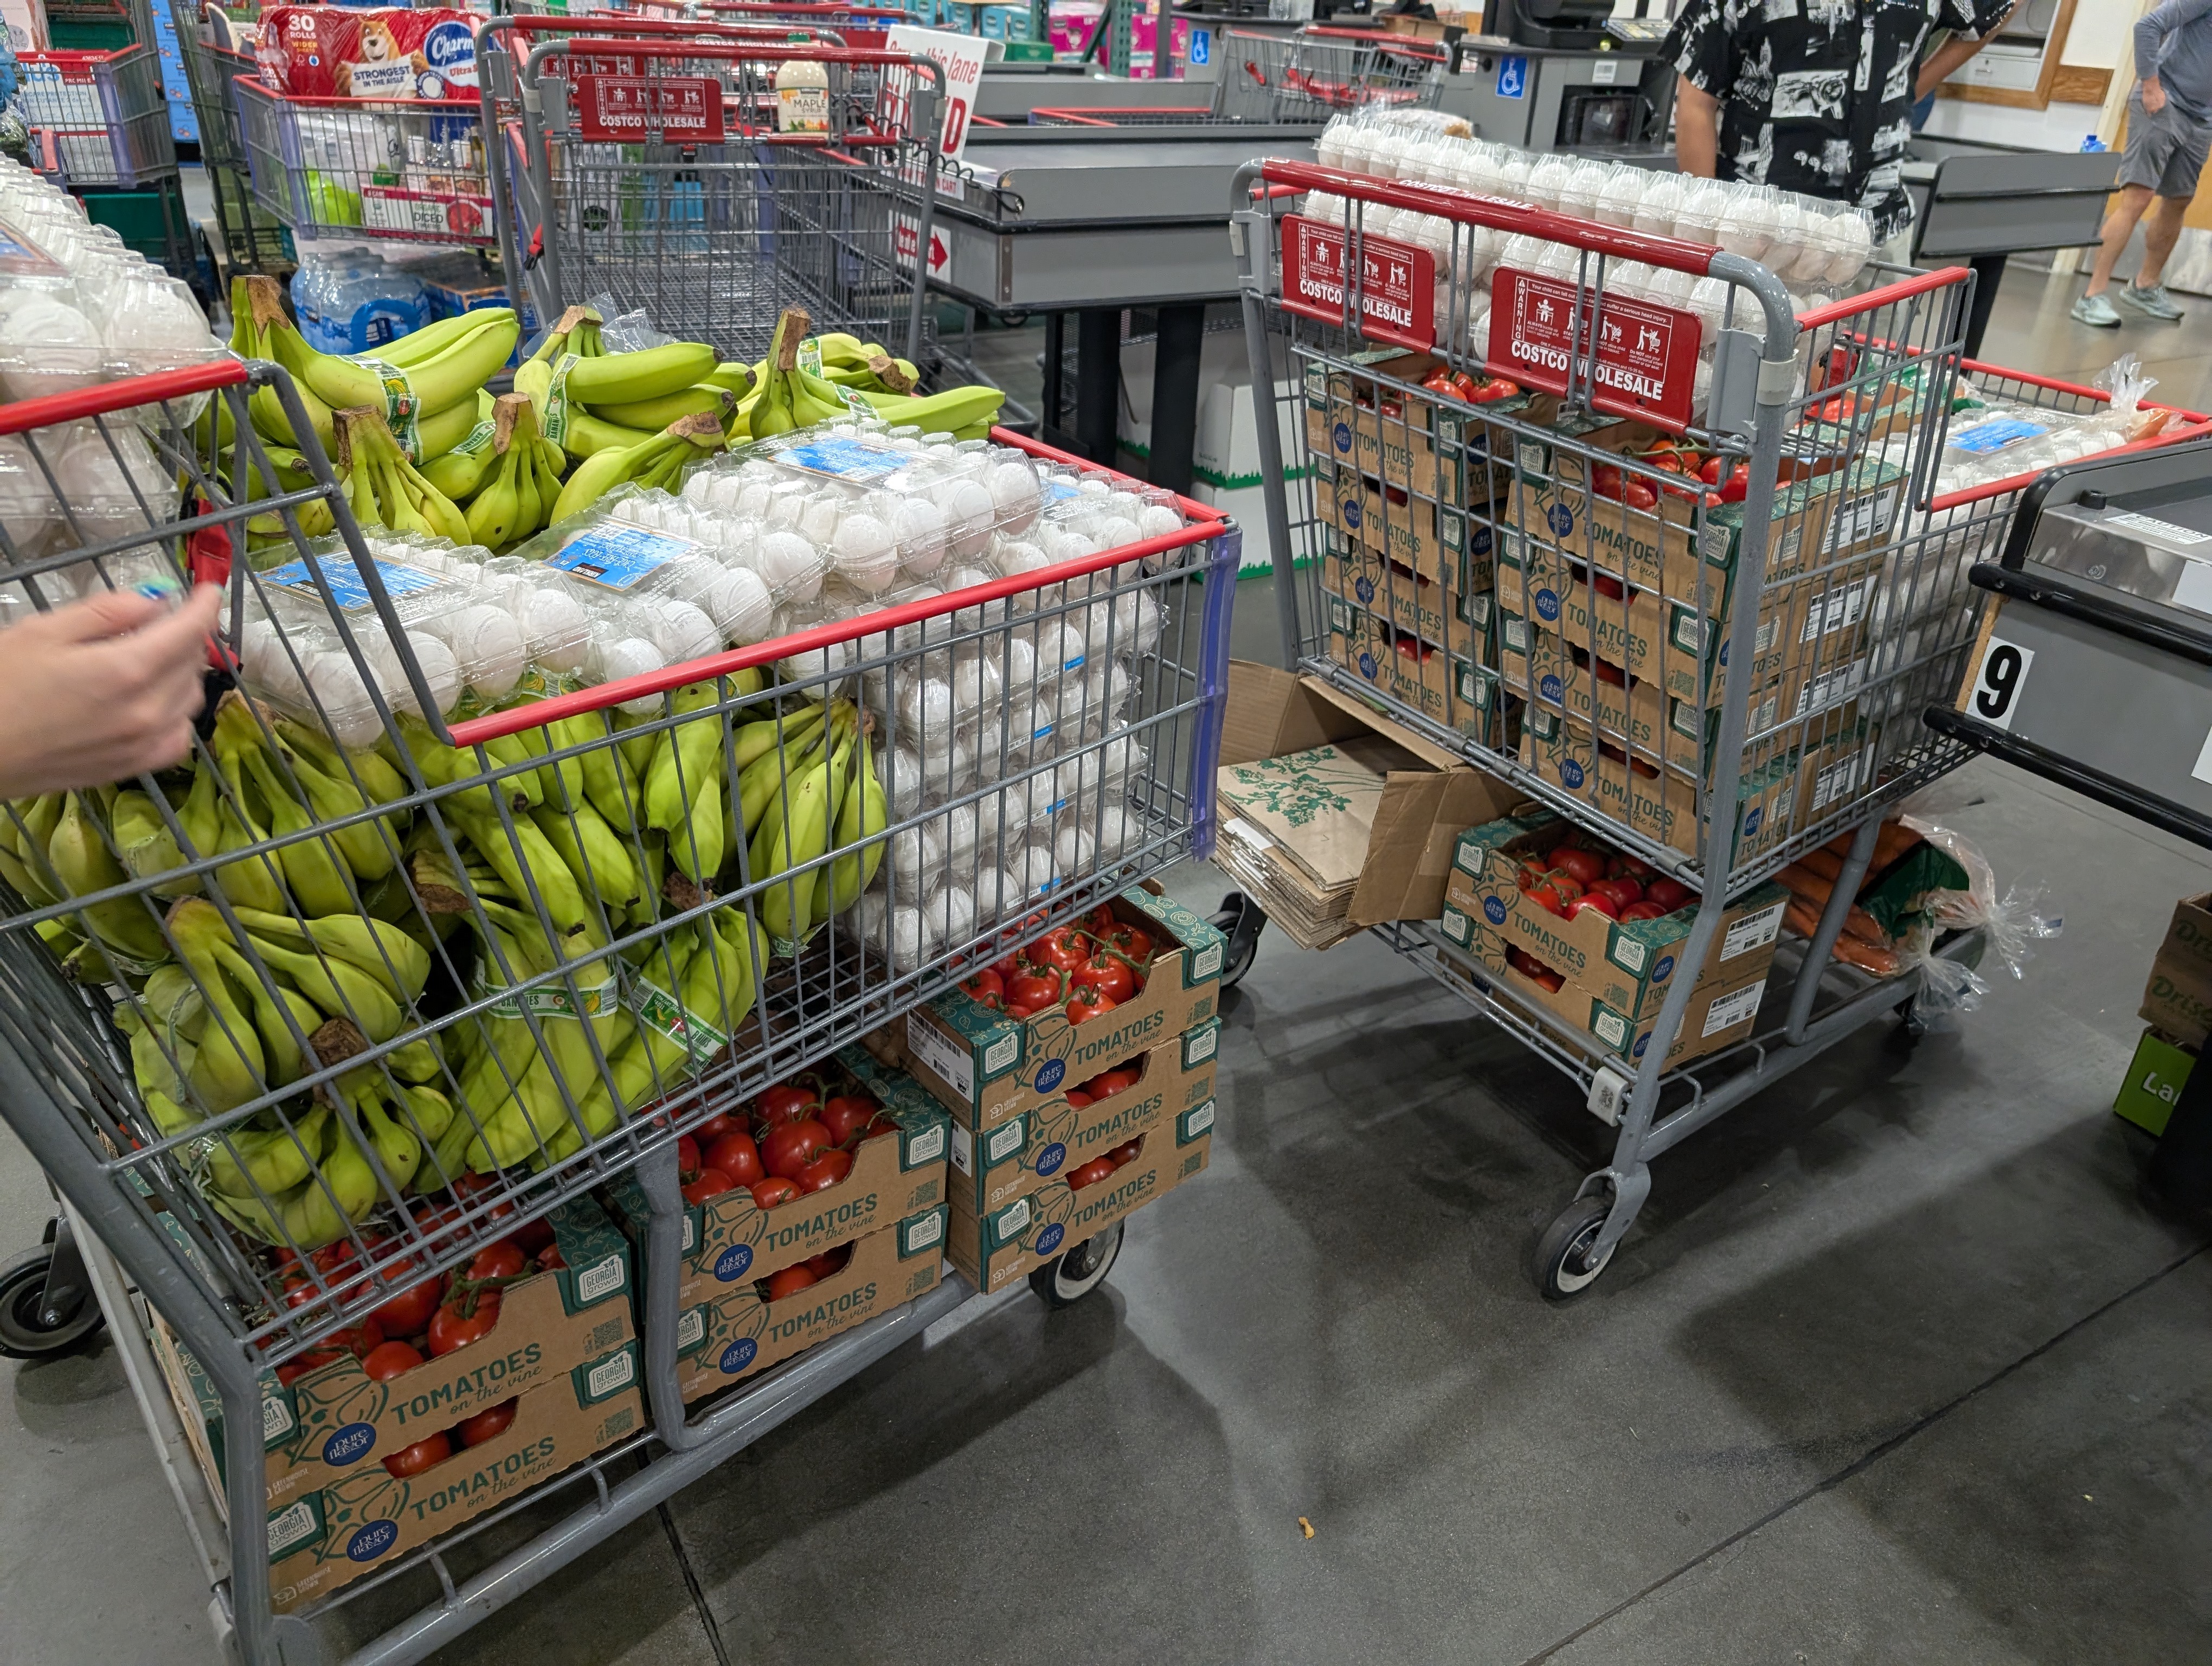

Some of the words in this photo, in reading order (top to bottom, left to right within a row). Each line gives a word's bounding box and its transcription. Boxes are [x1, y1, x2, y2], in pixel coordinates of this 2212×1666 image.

[288, 15, 314, 31] 30
[432, 34, 474, 66] Charm
[353, 66, 410, 81] STRONGEST
[450, 65, 472, 76] Ultra
[947, 51, 979, 84] lane
[372, 78, 385, 86] THE
[794, 99, 826, 108] MAPLE
[600, 116, 642, 127] COSTCO
[415, 212, 443, 223] DICED
[1300, 280, 1342, 305] COSTCO
[1349, 294, 1412, 328] WOLESALE
[1515, 287, 1526, 339] WARNING
[1652, 315, 1667, 323] injury.
[1512, 341, 1567, 371] COSTCO
[549, 412, 562, 440] BANANAS
[461, 430, 488, 451] BANANAS
[1521, 448, 1542, 466] GEORGIA
[1521, 460, 1540, 471] grown
[2136, 516, 2208, 538] CAUTION
[1607, 551, 1618, 563] on
[573, 566, 601, 579] KIRKLAND
[1541, 597, 1558, 608] pure
[1605, 643, 1621, 657] the
[1977, 645, 2022, 719] 9
[1632, 811, 1647, 826] the
[1461, 855, 1478, 868] grown
[1462, 847, 1481, 862] GEORGIA
[1446, 915, 1463, 931] GEORGIA
[1514, 912, 1586, 969] TOMATOES
[1198, 952, 1219, 967] GEORGIA
[1619, 949, 1638, 967] grown
[1620, 941, 1643, 961] GEORGIA
[1198, 958, 1221, 974] grown
[1534, 943, 1546, 954] on
[1546, 948, 1564, 966] the
[1561, 965, 1583, 978] vine
[1598, 1027, 1618, 1042] grown
[1600, 1017, 1621, 1036] GEORGIA
[1075, 1010, 1165, 1066] TOMATOES
[1105, 1050, 1120, 1063] on
[1121, 1038, 1139, 1055] the
[1139, 1028, 1162, 1045] vine
[1192, 1036, 1213, 1053] GEORGIA
[990, 1043, 1014, 1062] GEORGIA
[991, 1053, 1015, 1068] grown
[1192, 1044, 1214, 1060] grown
[1038, 1068, 1062, 1087] flavor
[1041, 1062, 1061, 1080] pure
[1003, 1091, 1025, 1110] GREENHOUSE
[1004, 1101, 1018, 1111] GROWN
[1076, 1093, 1163, 1149] TOMATOES
[1192, 1110, 1212, 1125] GEORGIA
[1193, 1115, 1213, 1130] grown
[1105, 1131, 1120, 1144] on
[1122, 1120, 1137, 1134] the
[1140, 1111, 1162, 1127] vine
[915, 1135, 938, 1151] GEORGIA
[994, 1131, 1020, 1149] GEORGIA
[995, 1139, 1021, 1154] grown
[915, 1146, 938, 1158] grown
[1041, 1147, 1062, 1163] pure
[1039, 1154, 1063, 1170] flavor
[1005, 1175, 1025, 1193] GREENHOUSE
[1005, 1186, 1019, 1195] GROWN
[1073, 1169, 1156, 1228] TOMATOES
[1102, 1209, 1116, 1222] on
[1117, 1197, 1133, 1212] the
[1134, 1186, 1155, 1202] vine
[766, 1193, 878, 1252] TOMATOES
[1002, 1210, 1026, 1229] GEORGIA
[1004, 1219, 1027, 1235] grown
[806, 1236, 822, 1249] on
[825, 1226, 845, 1240] the
[846, 1213, 876, 1229] vine
[913, 1222, 937, 1238] GEORGIA
[914, 1232, 937, 1244] grown
[1041, 1227, 1061, 1244] pure
[1038, 1234, 1062, 1250] flavor
[718, 1255, 749, 1275] flavor
[723, 1250, 748, 1268] pure
[586, 1267, 617, 1287] GEORGIA
[587, 1279, 617, 1293] grown
[769, 1282, 877, 1343] TOMATOES
[807, 1325, 823, 1338] on
[826, 1313, 846, 1328] the
[846, 1302, 875, 1320] vine
[723, 1350, 753, 1368] flavor
[728, 1342, 753, 1361] pure
[596, 1363, 627, 1383] GEORGIA
[597, 1375, 627, 1389] grown
[391, 1343, 542, 1426] TOMATOES
[449, 1399, 472, 1415] on
[475, 1385, 502, 1402] the
[504, 1365, 543, 1392] vine
[329, 1436, 369, 1458] flavor
[335, 1428, 368, 1450] pure
[410, 1436, 555, 1520] TOMATOES
[466, 1494, 487, 1509] on
[490, 1477, 517, 1494] the
[520, 1457, 556, 1482] vine
[352, 1532, 391, 1556] flavor
[358, 1524, 390, 1547] pure
